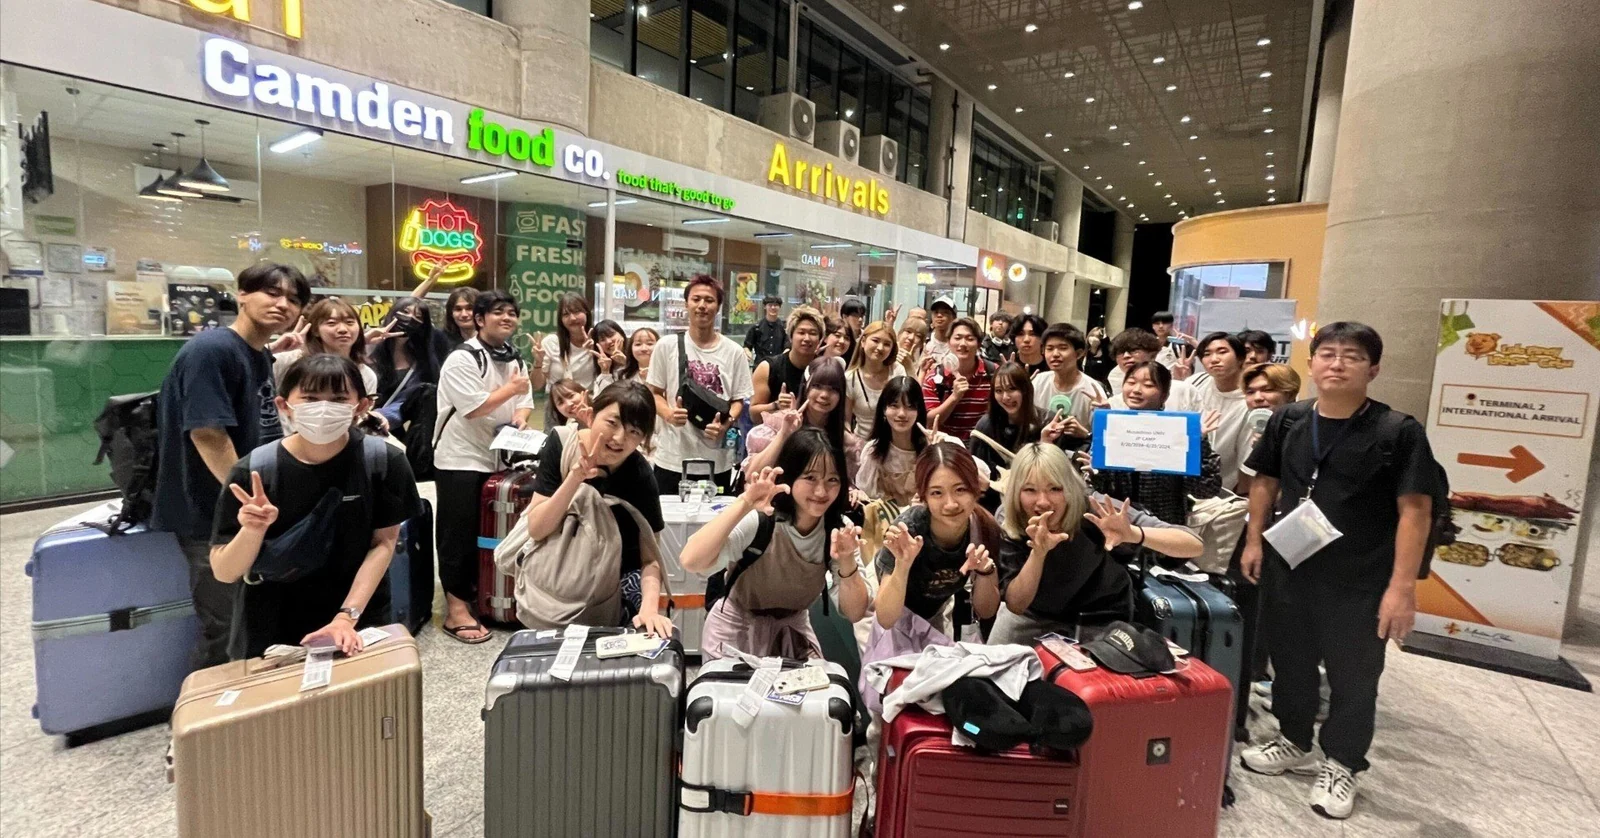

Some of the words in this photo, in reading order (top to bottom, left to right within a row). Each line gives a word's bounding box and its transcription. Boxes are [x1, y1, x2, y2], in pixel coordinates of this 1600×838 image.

[204, 37, 455, 145] Camden
[467, 108, 555, 167] food
[564, 144, 611, 181] co.
[768, 142, 890, 215] Arrivals
[617, 169, 648, 189] food
[649, 178, 682, 196] that's
[681, 188, 710, 202] good
[710, 191, 721, 206] to
[720, 198, 736, 210] go
[426, 212, 466, 232] HOT
[541, 214, 586, 236] FAST
[419, 229, 475, 249] DOGS
[1479, 398, 1535, 411] TERMINAL
[1535, 403, 1546, 411] 2
[1442, 406, 1529, 421] INTERNATIONAL
[1531, 413, 1581, 425] ARRIVAL
